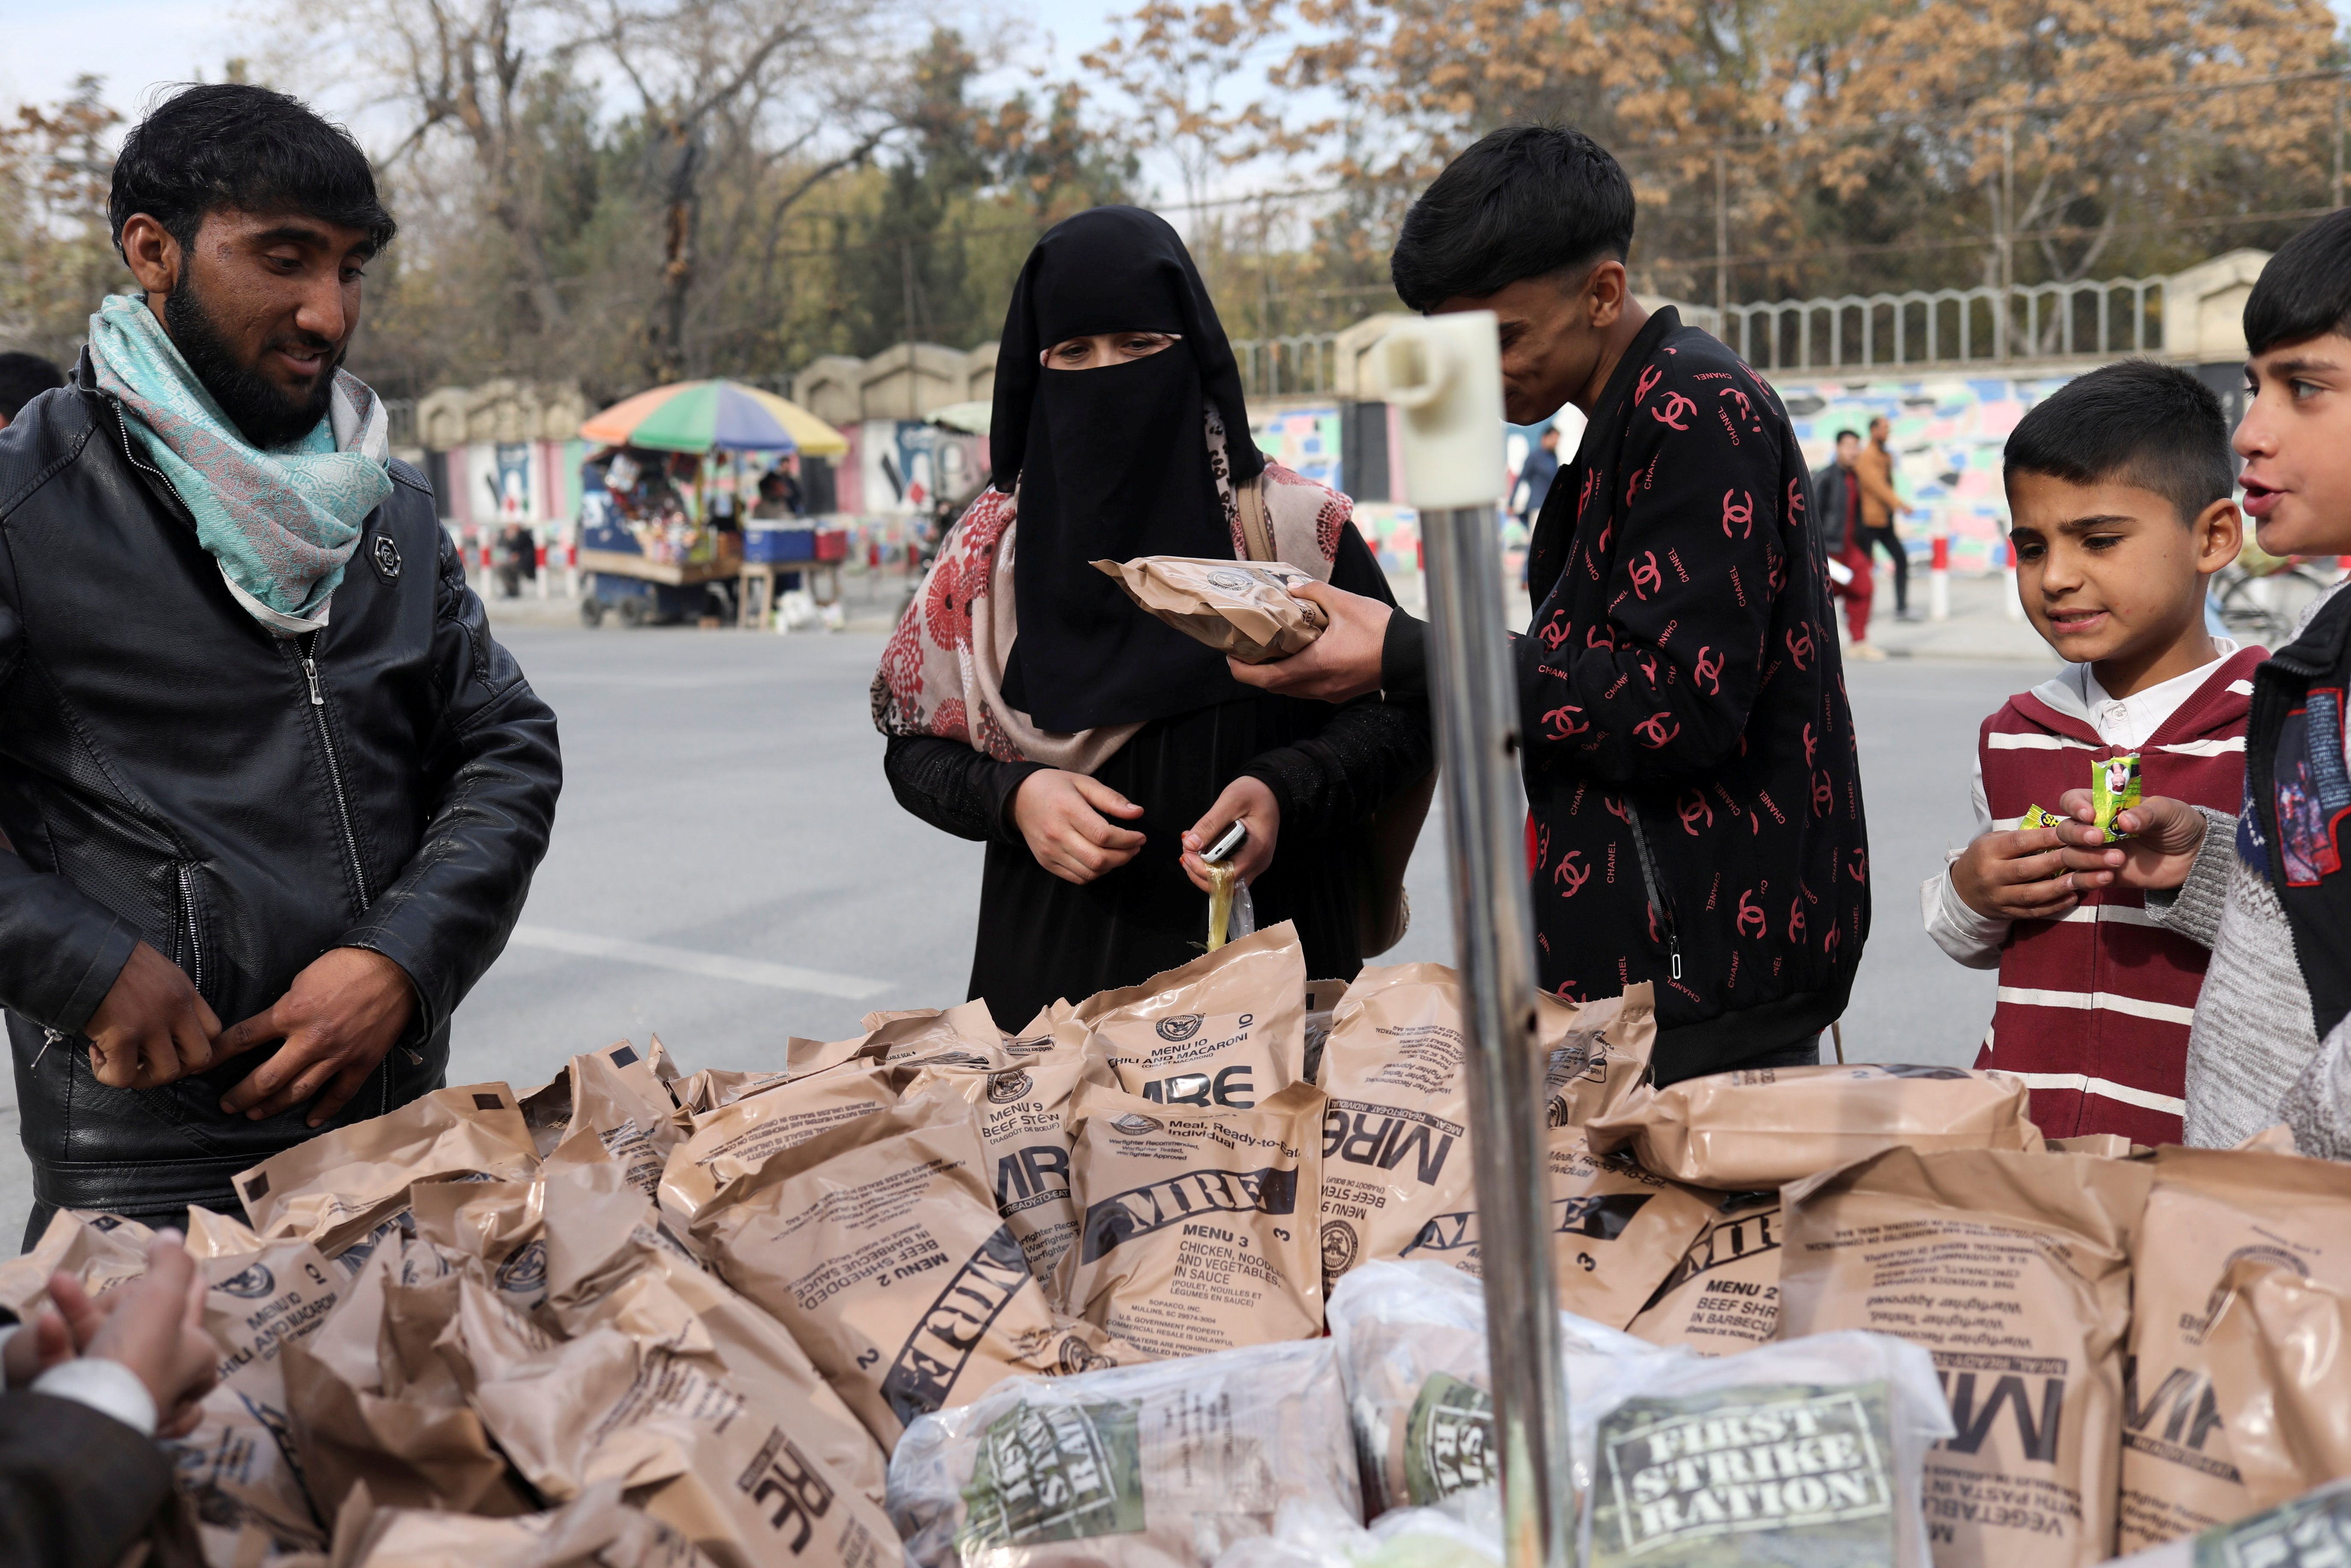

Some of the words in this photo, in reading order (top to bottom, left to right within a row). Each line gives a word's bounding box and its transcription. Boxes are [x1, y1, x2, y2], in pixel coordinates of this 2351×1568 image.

[1718, 406, 1739, 446] CHANEL
[1644, 450, 1661, 489] CHANE
[1668, 547, 1689, 583] CHANEL
[1729, 566, 1746, 607] CHANEL
[1658, 620, 1677, 649] CHANE
[1539, 665, 1568, 681] CHANE
[1714, 781, 1741, 816] CHANEL
[1759, 789, 1785, 824] CHANEL
[1847, 778, 1856, 820] CHANEL
[1607, 841, 1616, 884] CHANEL
[1706, 872, 1721, 911] CHANEL
[1727, 950, 1738, 988] CHANEL
[1666, 976, 1700, 1003] CHANEL
[1108, 1058, 1139, 1069] CHILI
[1143, 1055, 1173, 1064] AND
[1176, 1032, 1248, 1060] MACARONI
[1152, 1043, 1191, 1057] MENU
[1140, 1065, 1255, 1109] MRE
[990, 1102, 1030, 1123] MENU
[1033, 1102, 1043, 1111] 9
[1331, 1100, 1369, 1113] INDIVIDUAL
[983, 1120, 1017, 1138] BEEF
[1020, 1114, 1060, 1127] STEW
[1169, 1120, 1208, 1129] Meal,
[990, 1127, 1022, 1145] (RAGOÛT
[1168, 1129, 1235, 1150] Individual
[733, 1141, 773, 1158] UNLAWFUL
[1323, 1111, 1454, 1186] MRE
[1356, 1182, 1385, 1194] (RAGOÛT
[1005, 1190, 1068, 1214] READY-TO-EAT
[1117, 1172, 1270, 1233] MRE
[1322, 1202, 1331, 1212] 9
[1353, 1192, 1386, 1208] BEEF
[1334, 1203, 1367, 1220] MENU
[914, 1230, 931, 1240] IN
[1025, 1232, 1072, 1253] Warfighter
[1183, 1224, 1234, 1242] MENU
[1238, 1236, 1249, 1247] 3
[1273, 1228, 1290, 1241] 3
[841, 1236, 912, 1271] BARBECUE
[898, 1239, 939, 1260] BEEF
[1177, 1253, 1202, 1267] AND
[1180, 1241, 1234, 1260] CHICKEN,
[895, 1253, 949, 1279] MENU
[1577, 1253, 1596, 1272] 3
[794, 1268, 839, 1300] SAUCE
[798, 1258, 895, 1310] SHREDDED,
[877, 1274, 891, 1287] 2
[1174, 1265, 1186, 1277] IN
[1190, 1269, 1231, 1285] SAUCE
[1170, 1286, 1209, 1300] LÉGUMES
[1211, 1294, 1222, 1302] EN
[1224, 1296, 1254, 1307] SAUCE)
[1172, 1280, 1208, 1292] (POULET,
[1211, 1286, 1249, 1297] NOUILLES
[1706, 1279, 1761, 1296] MENU
[1764, 1287, 1779, 1300] 2
[246, 1297, 289, 1331] MENU
[1131, 1305, 1164, 1316] MULLINS,
[1149, 1300, 1185, 1311] SOPAKCO,
[1697, 1297, 1739, 1311] BEEF
[903, 1252, 1028, 1387] MRE
[1134, 1317, 1184, 1330] GOVERNMENT
[1187, 1326, 1224, 1336] PROPERTY
[1706, 1314, 1773, 1333] BARBECU
[1106, 1319, 1154, 1333] COMMERCIAL
[1157, 1329, 1184, 1338] RESALE
[1195, 1335, 1234, 1347] UNLAWFUL
[1127, 1335, 1158, 1345] HEATERS
[857, 1348, 879, 1369] 2
[1143, 1345, 1170, 1356] SEALED
[1648, 1408, 1823, 1463] FIRST
[1632, 1432, 1864, 1502] STRIKE
[1639, 1472, 1872, 1537] RATION
